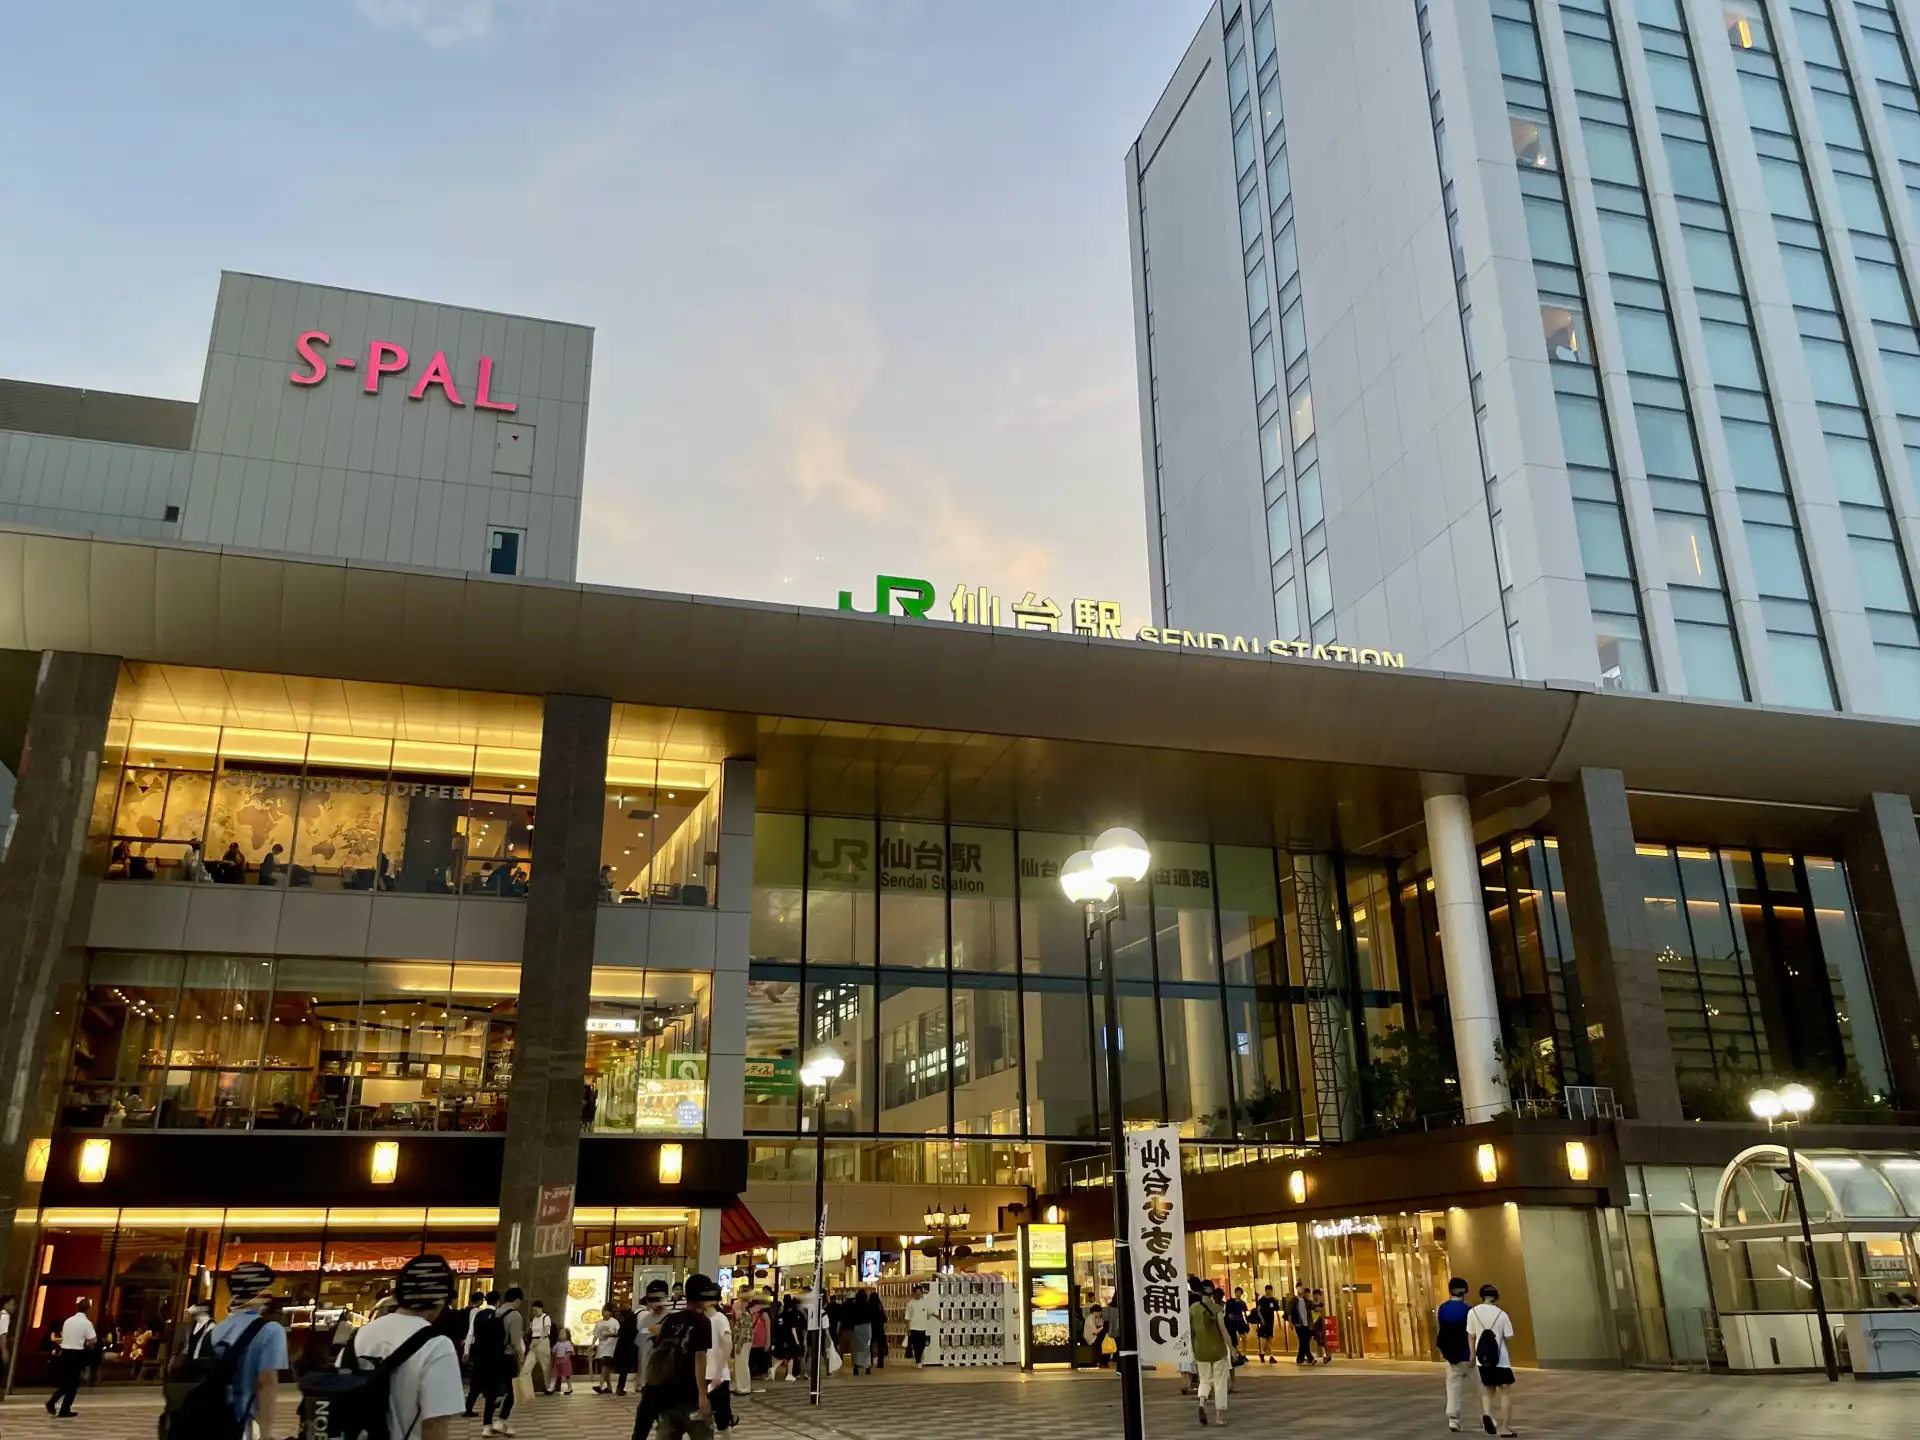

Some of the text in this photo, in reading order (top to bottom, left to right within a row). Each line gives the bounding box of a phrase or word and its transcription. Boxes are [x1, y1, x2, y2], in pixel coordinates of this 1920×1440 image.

[290, 330, 518, 413] S-PAL
[838, 574, 936, 619] JR
[949, 583, 1122, 640] 仙台駅
[810, 837, 868, 871] JR
[880, 836, 983, 873] 仙台駅
[880, 871, 984, 893] Sendai Station
